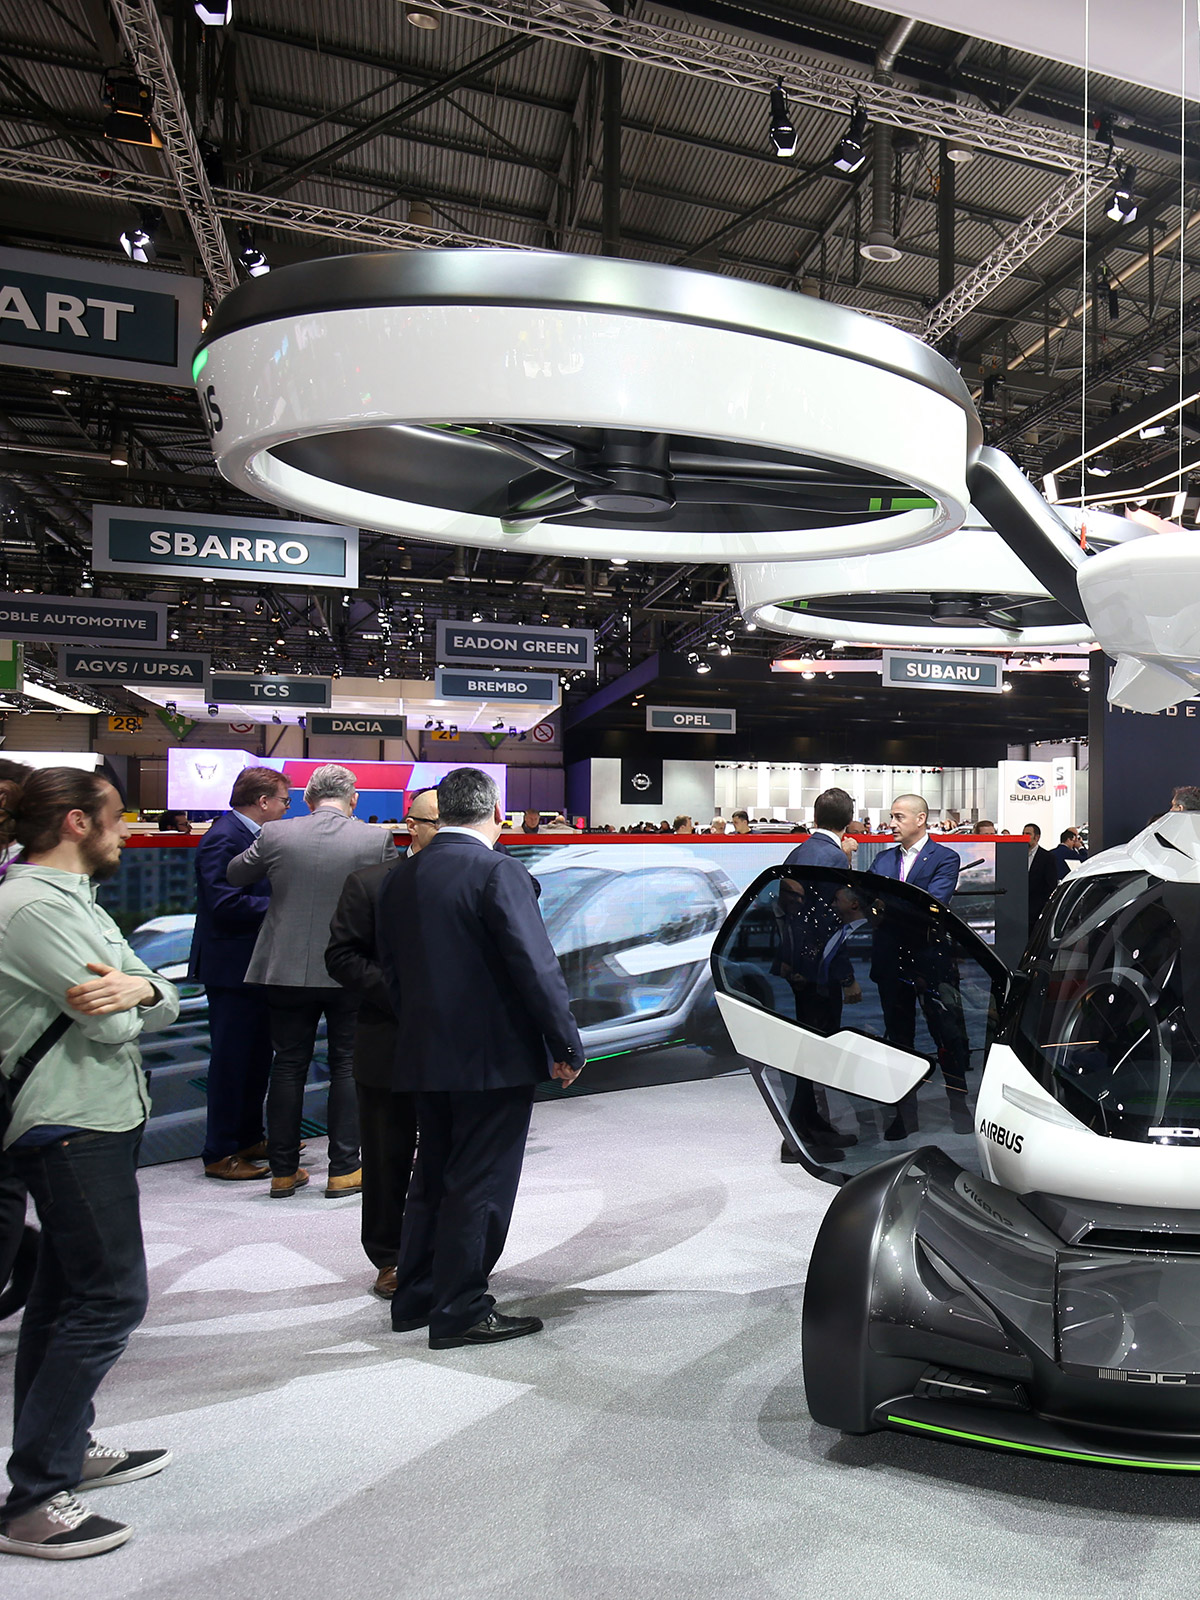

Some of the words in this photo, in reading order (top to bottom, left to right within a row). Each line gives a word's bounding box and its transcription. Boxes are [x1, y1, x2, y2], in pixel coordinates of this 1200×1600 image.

[150, 531, 309, 565] SBARRO
[42, 613, 147, 630] AUTOMOTIVE
[453, 635, 518, 651] EADON
[522, 640, 579, 655] GREEN
[75, 659, 128, 673] AGVS
[143, 662, 194, 676] UPSA
[906, 662, 981, 681] SUBARU
[249, 683, 290, 697] TCS
[468, 680, 528, 693] BREMBO
[332, 720, 383, 733] DACIA
[673, 714, 711, 726] OPEL
[1009, 794, 1051, 802] SUBARU
[979, 1118, 1024, 1154] AIRBUS
